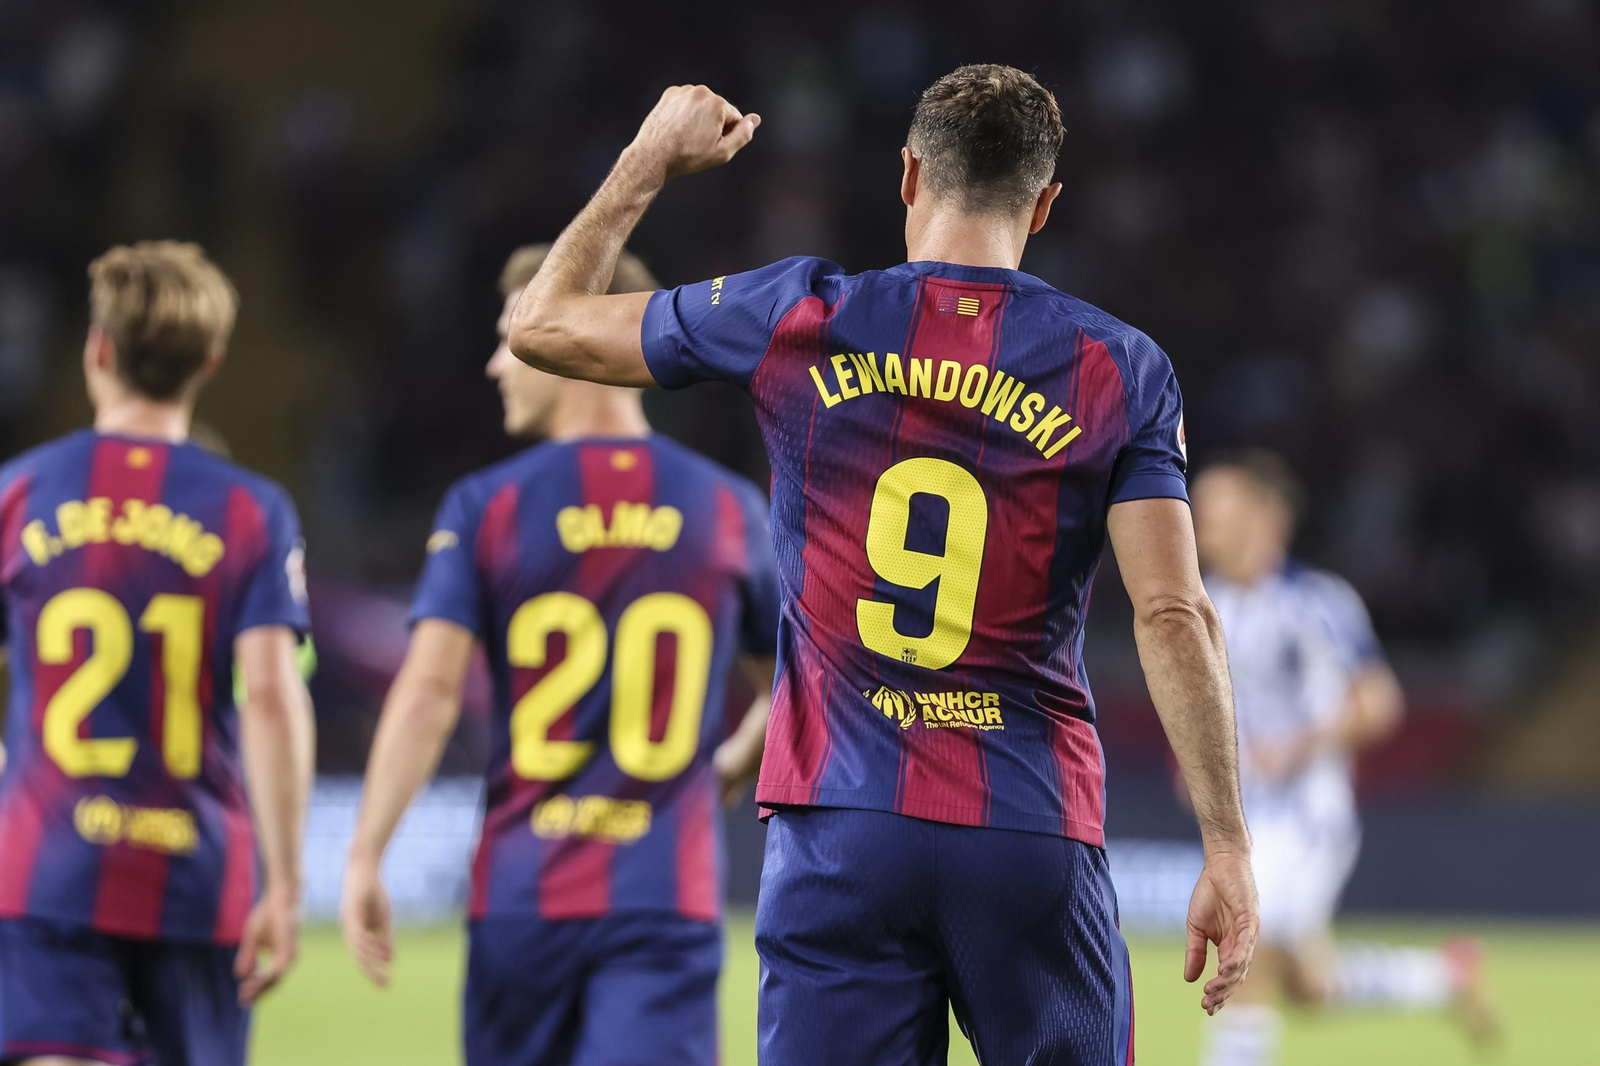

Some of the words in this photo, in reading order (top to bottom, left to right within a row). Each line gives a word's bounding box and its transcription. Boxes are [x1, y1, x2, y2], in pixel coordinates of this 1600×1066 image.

[808, 351, 1083, 461] LEWANDOWSKI
[856, 457, 989, 671] 9
[36, 586, 204, 780] 21
[507, 591, 713, 783] 20
[913, 691, 1000, 710] UNHCR
[922, 704, 1003, 725] ACNUR
[924, 721, 939, 729] The
